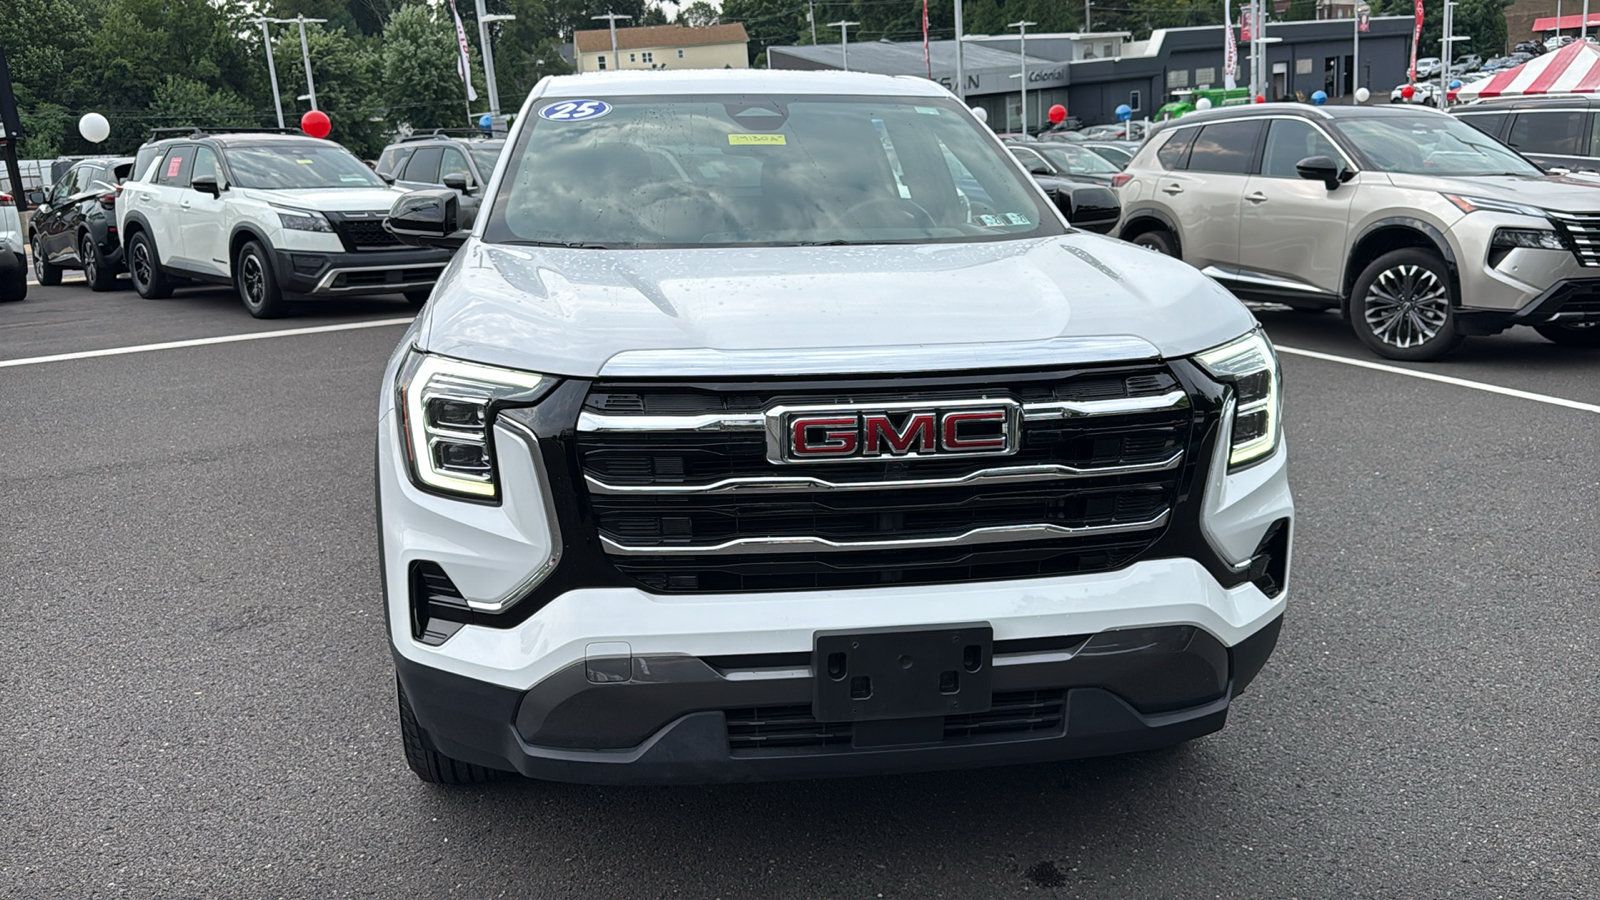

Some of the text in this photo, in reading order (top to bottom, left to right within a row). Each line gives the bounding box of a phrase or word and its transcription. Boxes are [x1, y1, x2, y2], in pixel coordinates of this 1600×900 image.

[1029, 69, 1065, 83] Colonial
[549, 102, 600, 119] 25
[791, 409, 1007, 457] GMC
